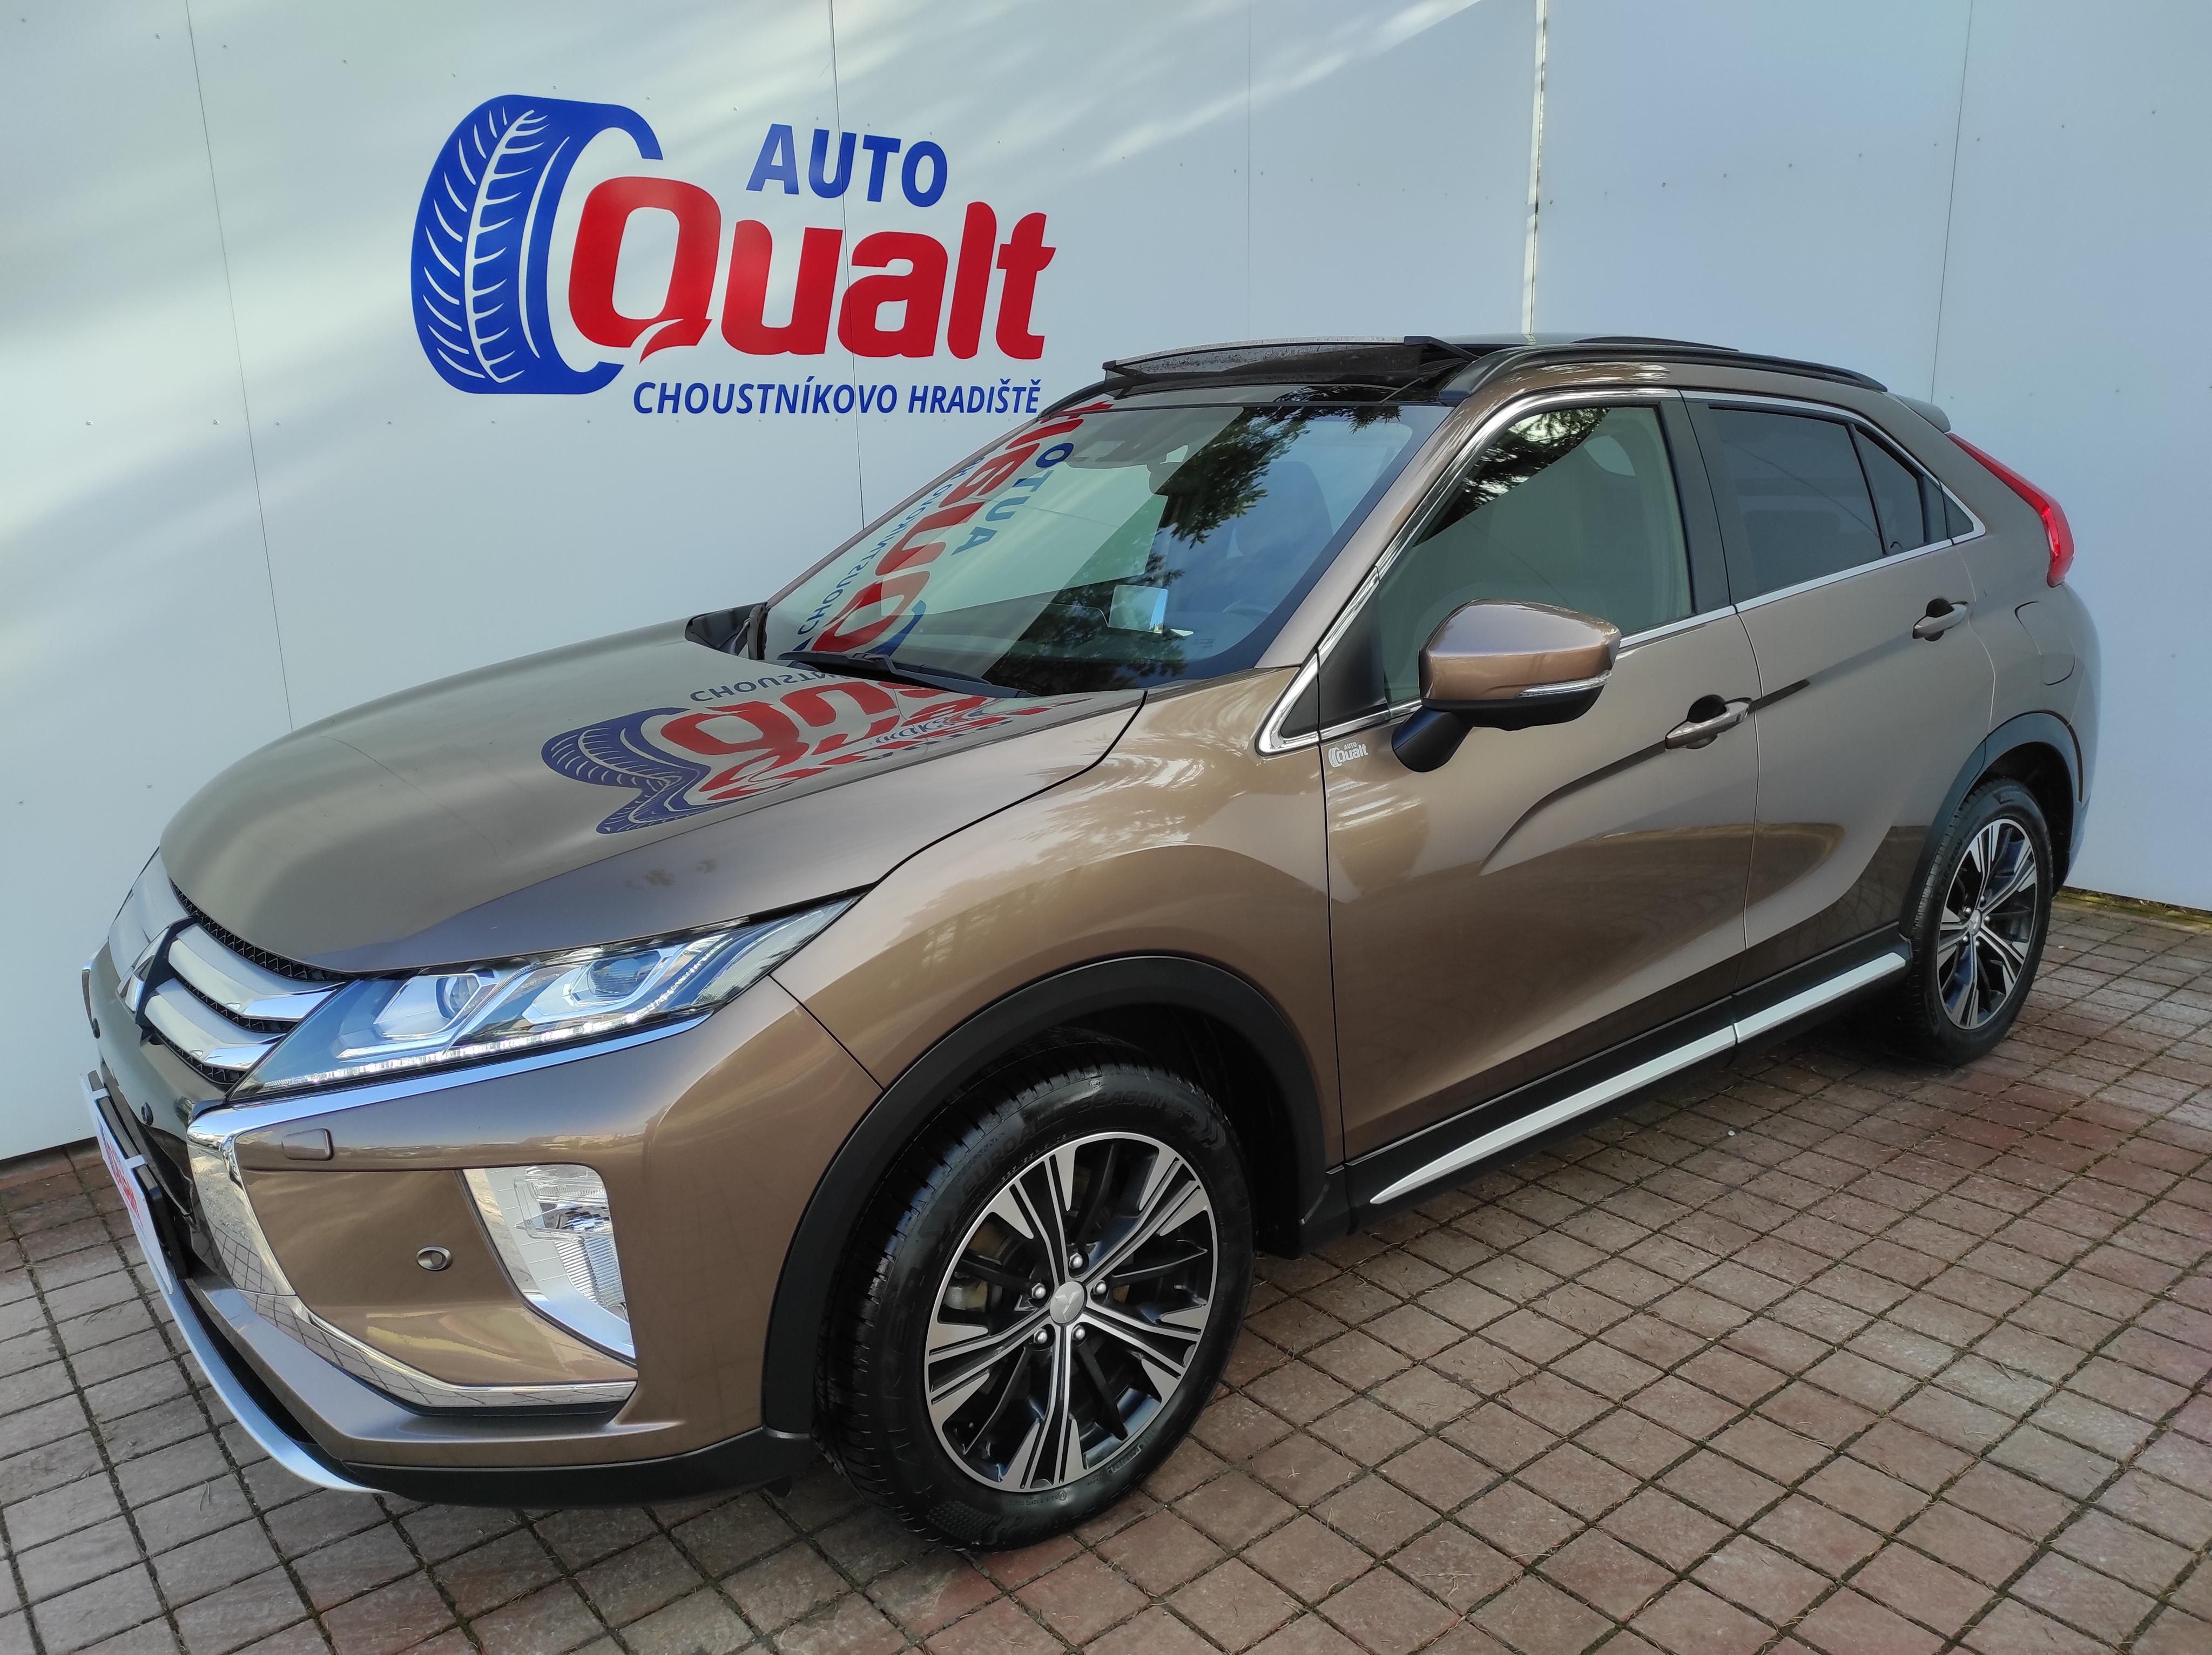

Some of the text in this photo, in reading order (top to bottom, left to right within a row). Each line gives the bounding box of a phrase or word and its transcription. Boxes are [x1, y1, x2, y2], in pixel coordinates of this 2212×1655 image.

[746, 123, 948, 208] AUTO
[568, 176, 1056, 363] Qualt
[632, 375, 1042, 415] CHOUSTNÍKOVO HRADIŠTĚ
[1336, 743, 1368, 762] Qualt
[1344, 741, 1357, 750] AUTO
